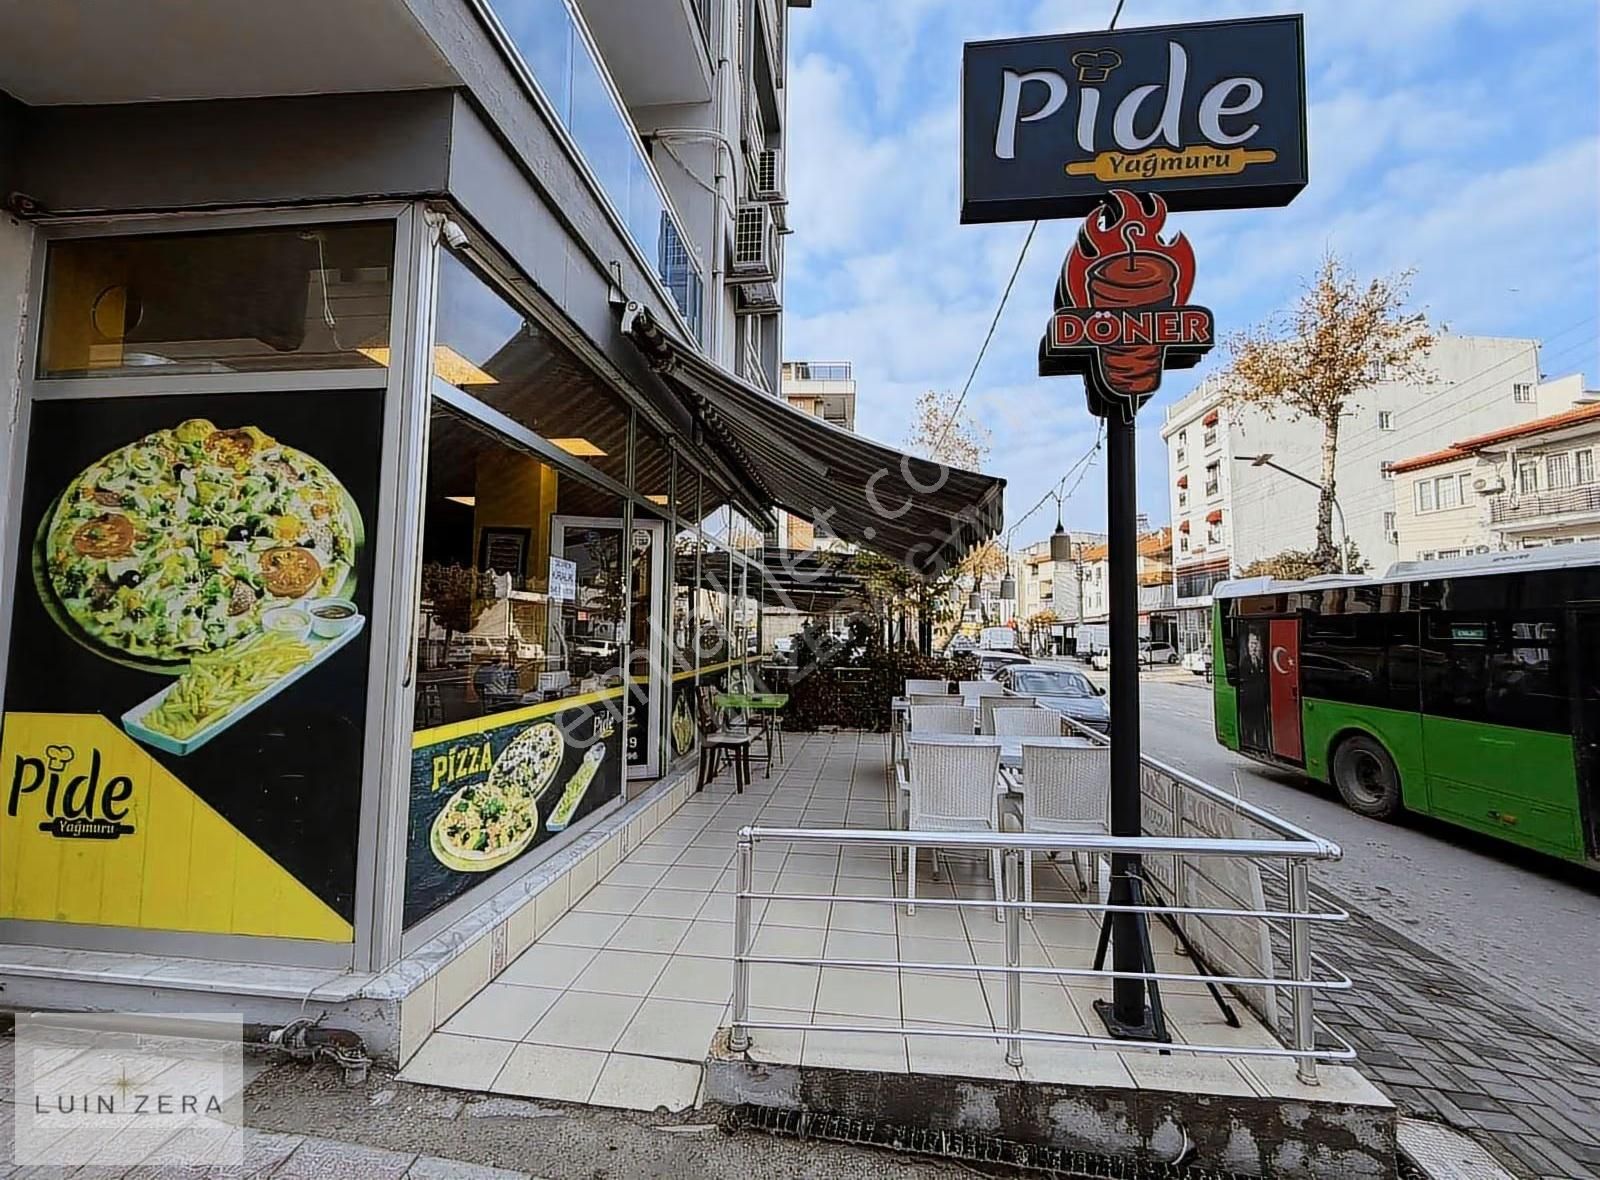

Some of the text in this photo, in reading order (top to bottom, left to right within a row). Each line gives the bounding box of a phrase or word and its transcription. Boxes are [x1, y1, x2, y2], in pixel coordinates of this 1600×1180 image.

[995, 41, 1263, 159] Pide
[1109, 153, 1230, 178] Yağmuru
[1055, 310, 1210, 346] DÖNER
[8, 748, 133, 821] Pide
[60, 820, 115, 836] Yağmuru
